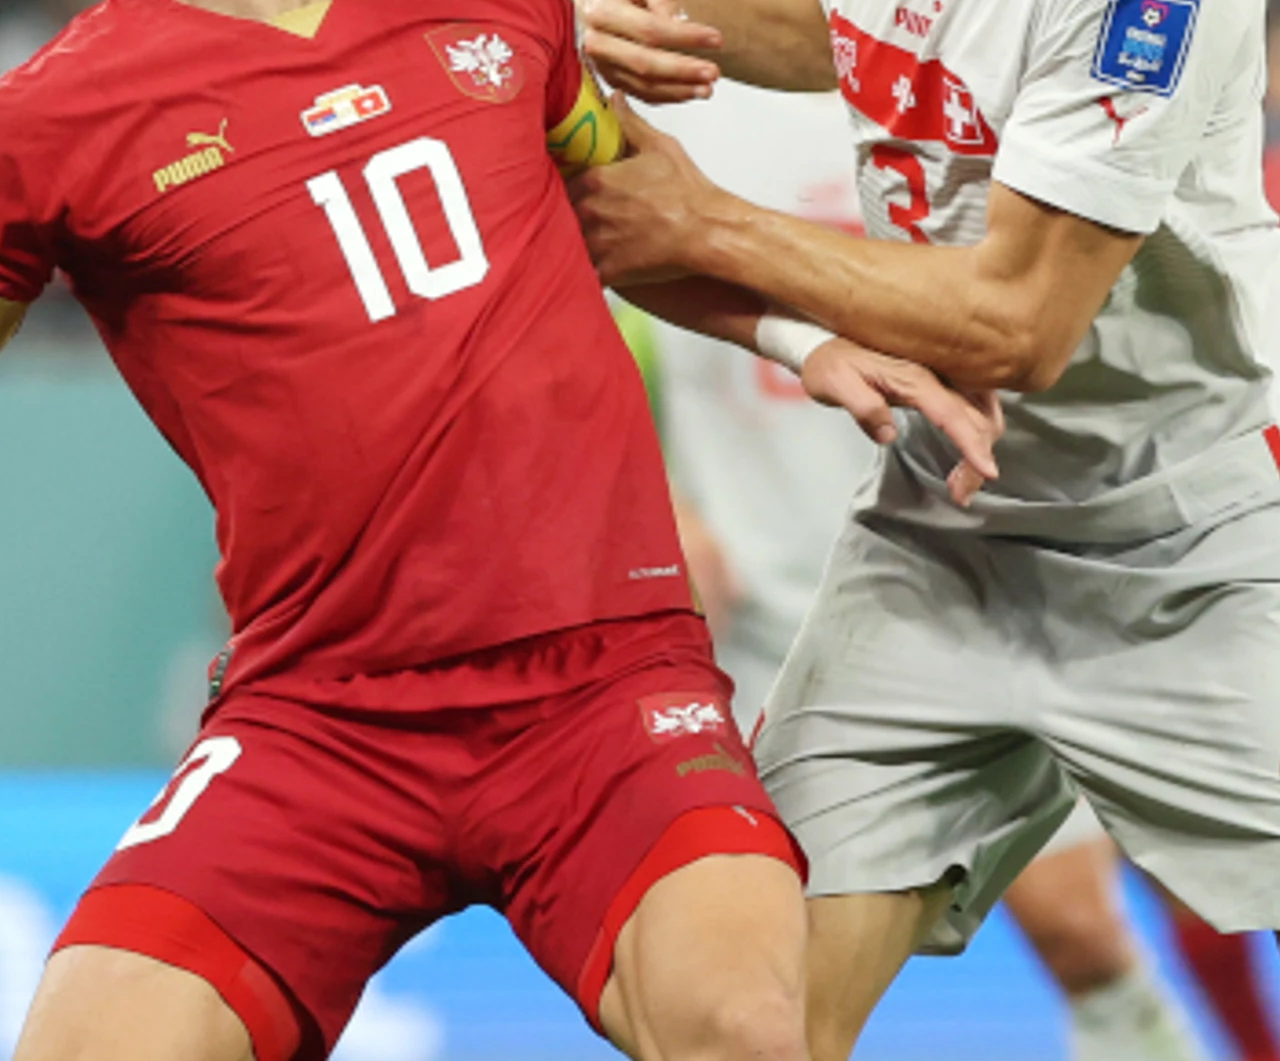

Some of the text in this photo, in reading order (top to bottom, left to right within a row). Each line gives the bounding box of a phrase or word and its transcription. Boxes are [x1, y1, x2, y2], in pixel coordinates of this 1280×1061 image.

[152, 146, 224, 193] PUMA
[870, 143, 931, 244] 3
[304, 137, 491, 323] 10
